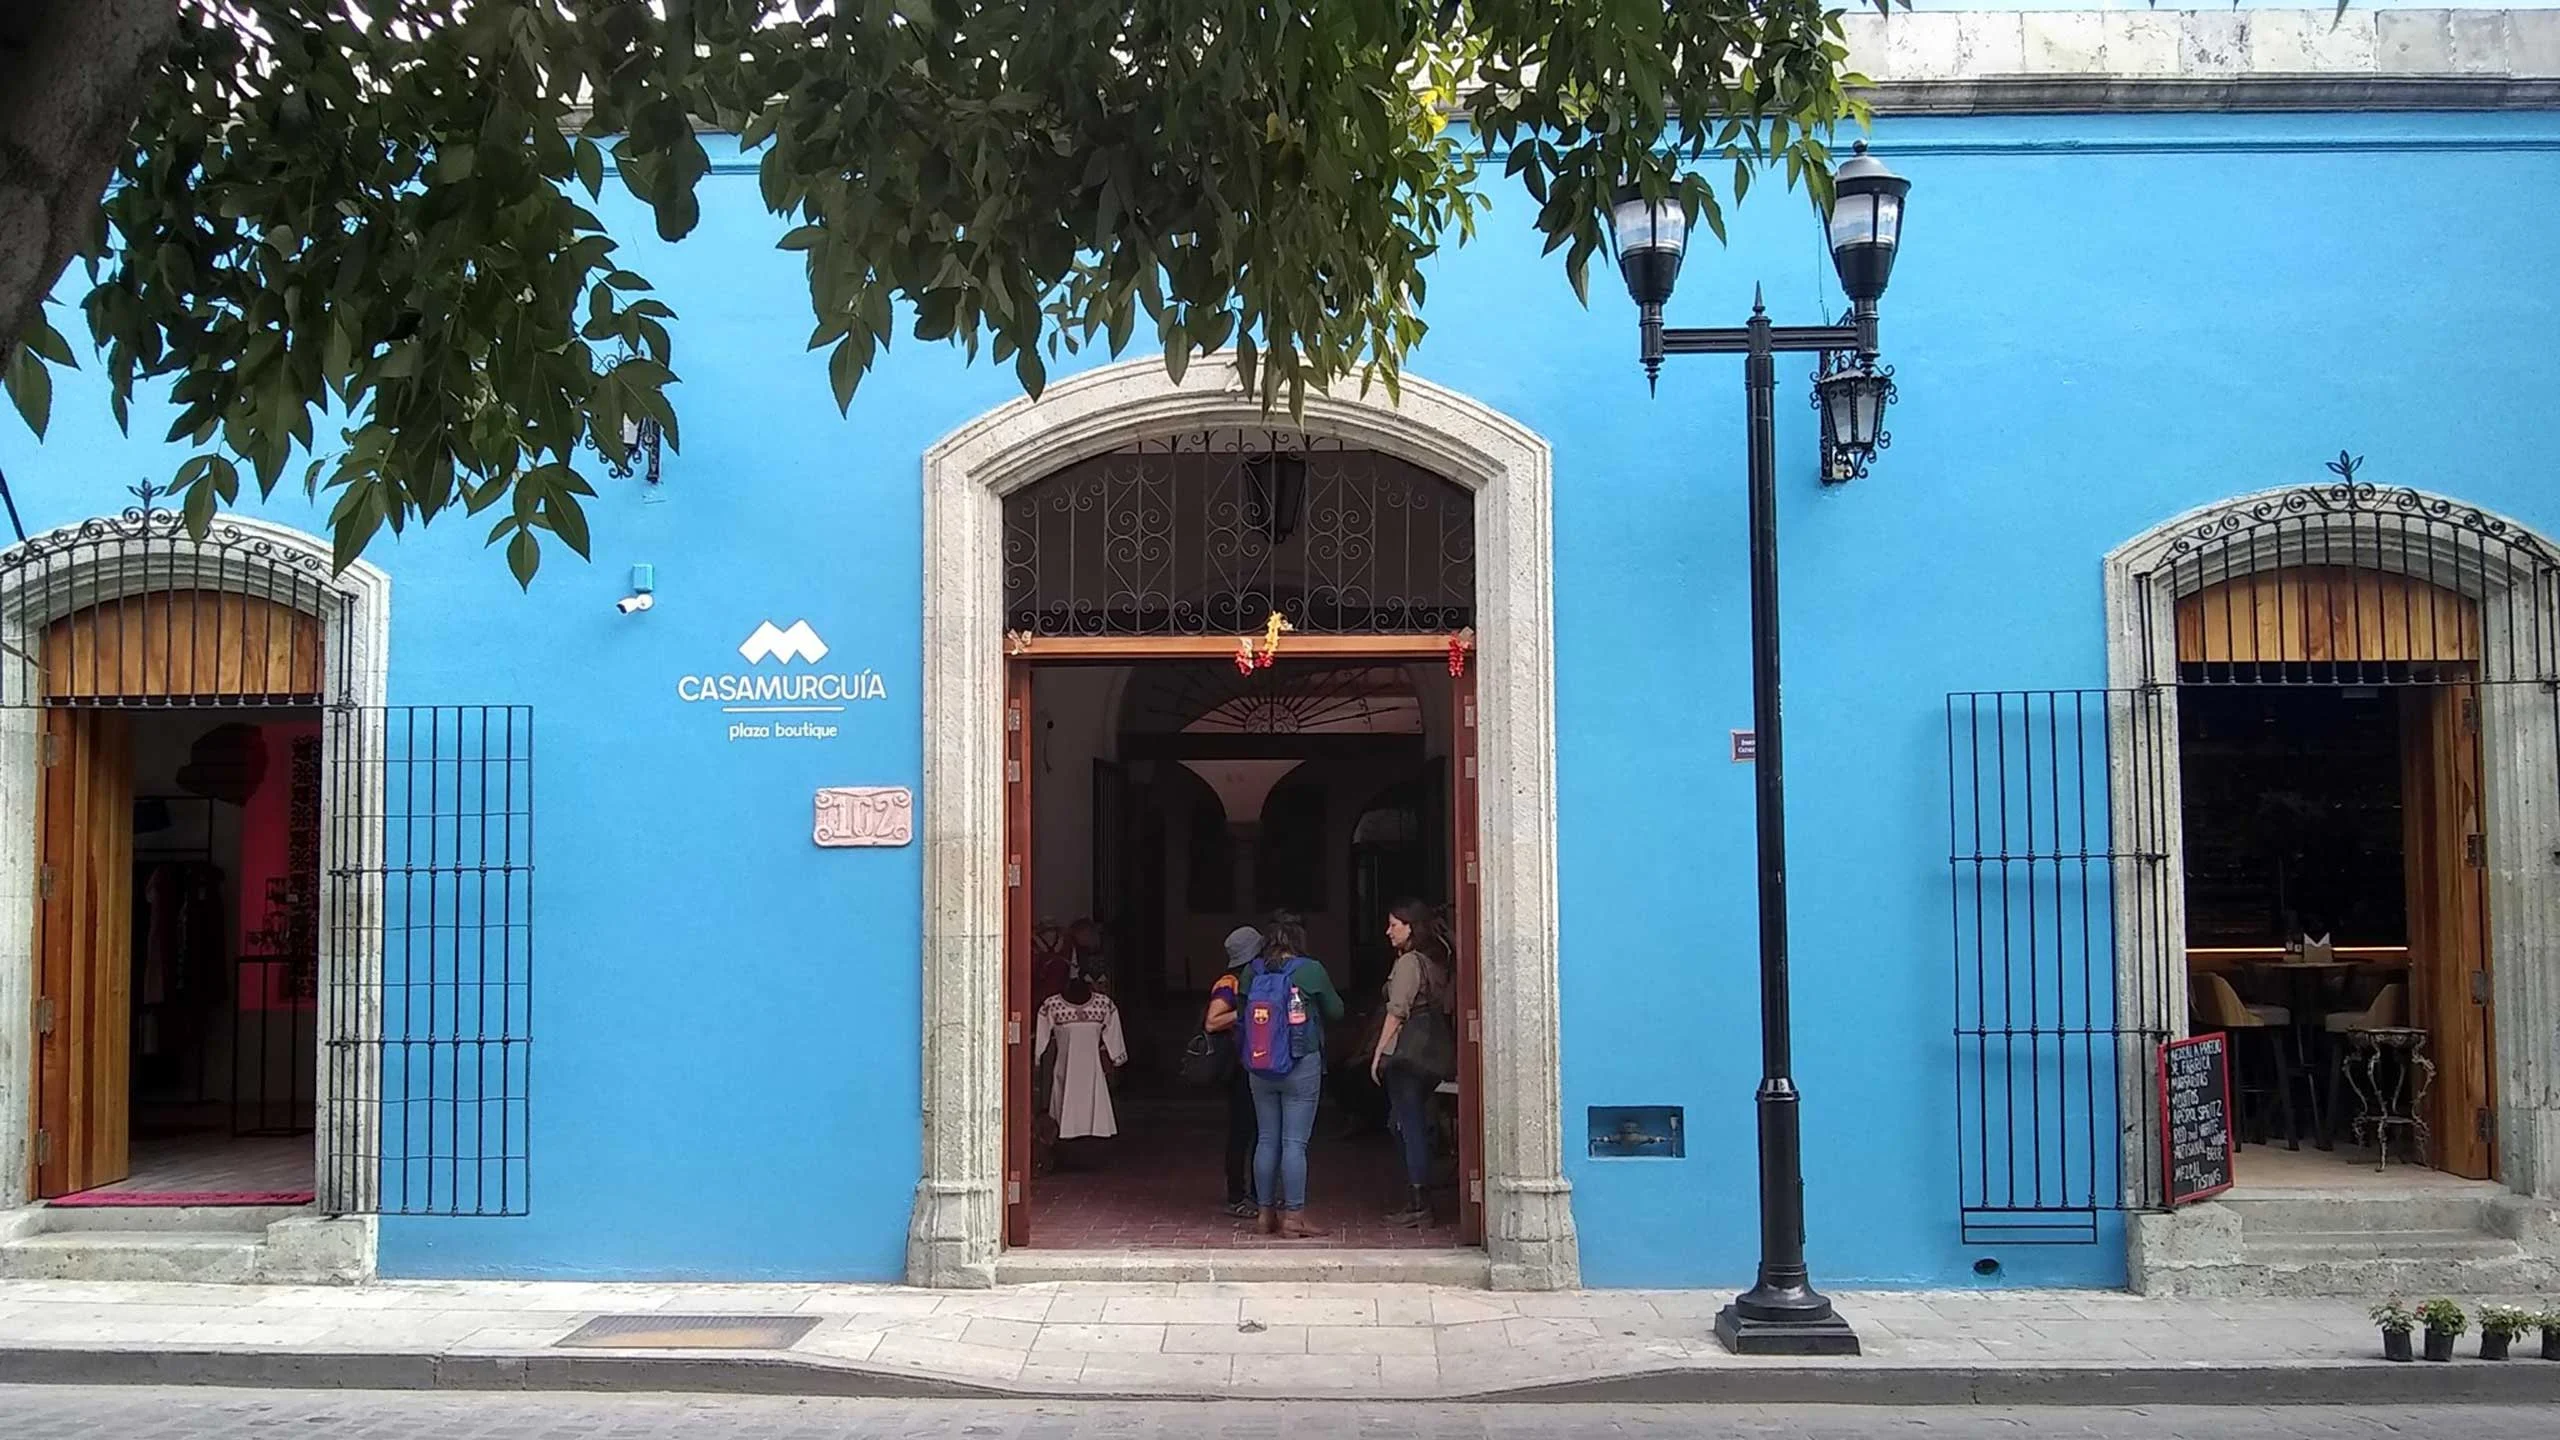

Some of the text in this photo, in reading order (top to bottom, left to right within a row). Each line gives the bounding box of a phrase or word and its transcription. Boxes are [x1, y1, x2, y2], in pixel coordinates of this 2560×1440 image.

[678, 668, 887, 701] CASAMURGUÍA
[729, 722, 838, 742] plaza boutique
[832, 797, 897, 839] 102
